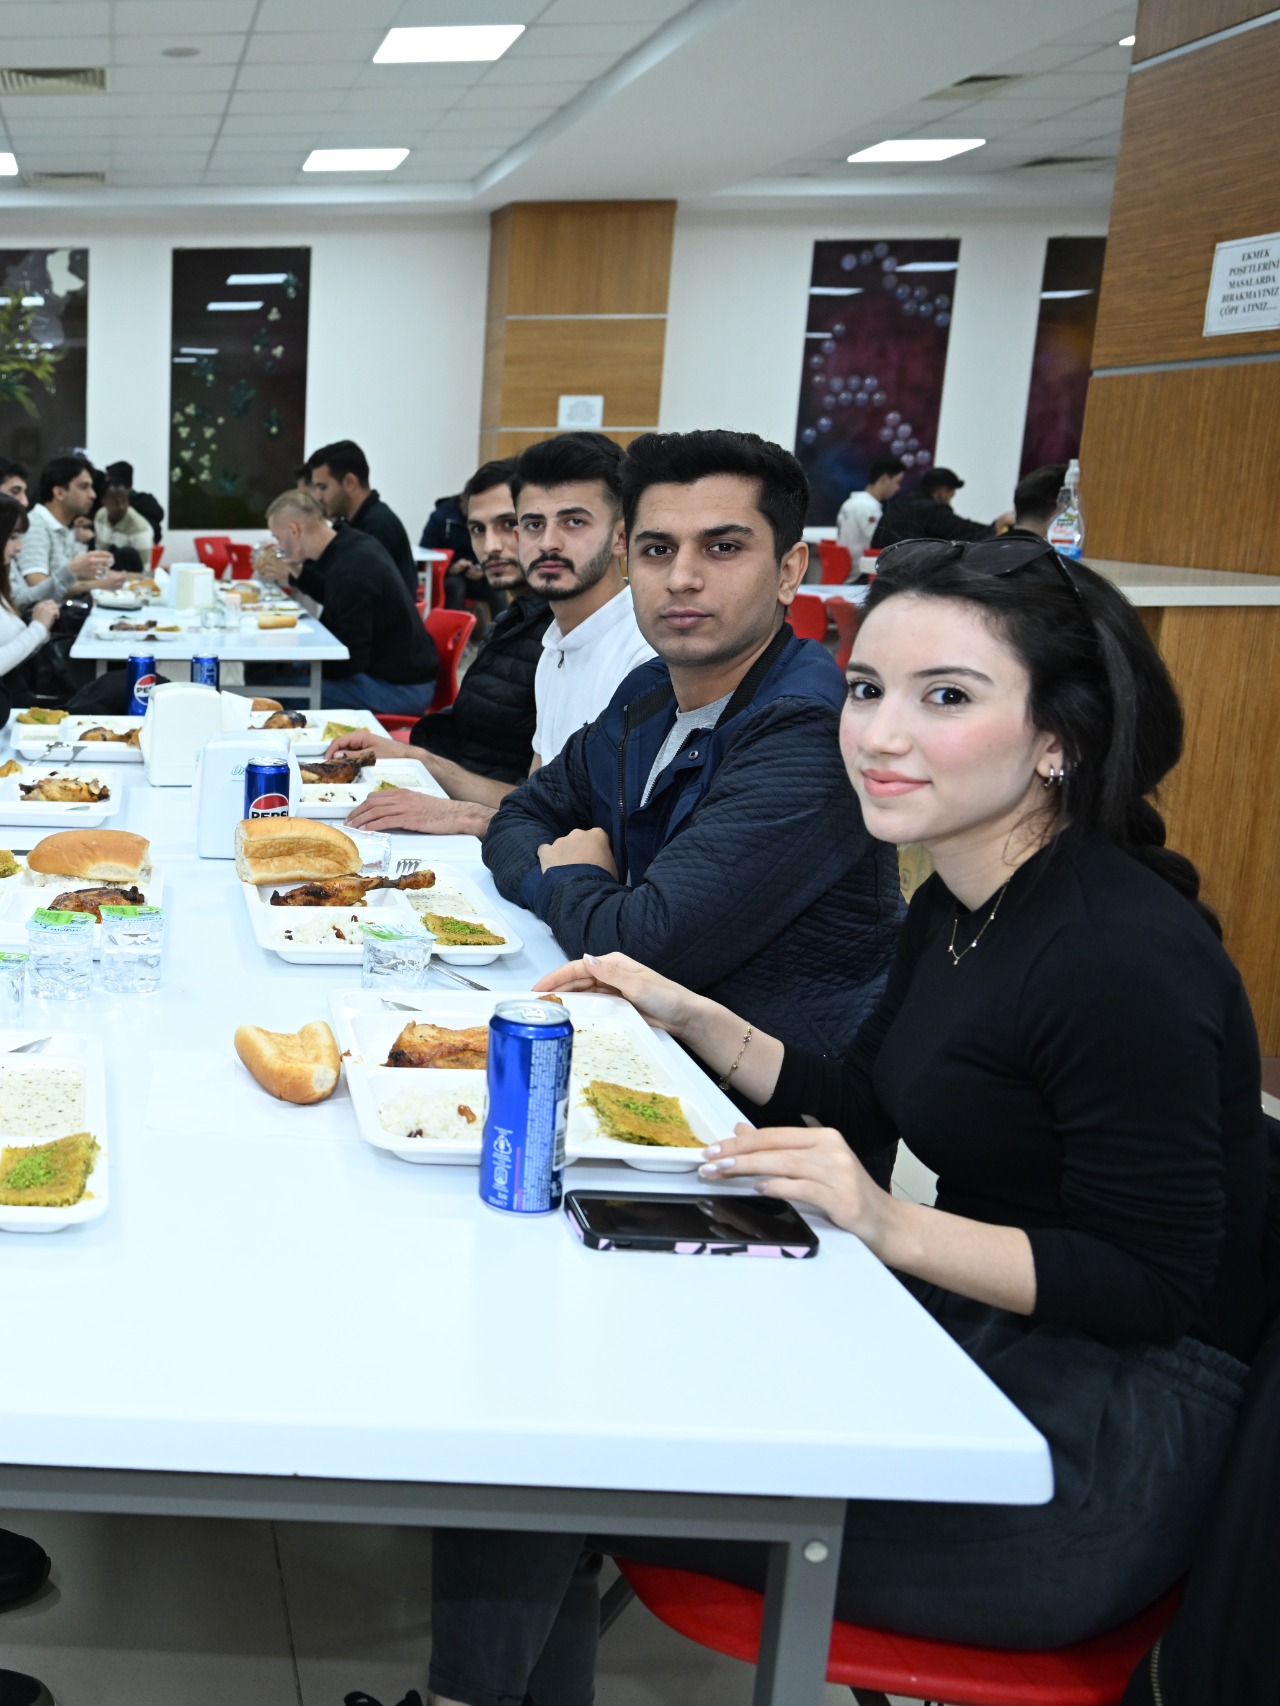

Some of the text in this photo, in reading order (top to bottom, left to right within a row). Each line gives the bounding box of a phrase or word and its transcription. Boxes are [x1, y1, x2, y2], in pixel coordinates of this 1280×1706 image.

[1242, 249, 1271, 261] EKMEK
[1229, 275, 1276, 289] MASALARDA
[1222, 287, 1279, 303] BIRAKMAYINIZ
